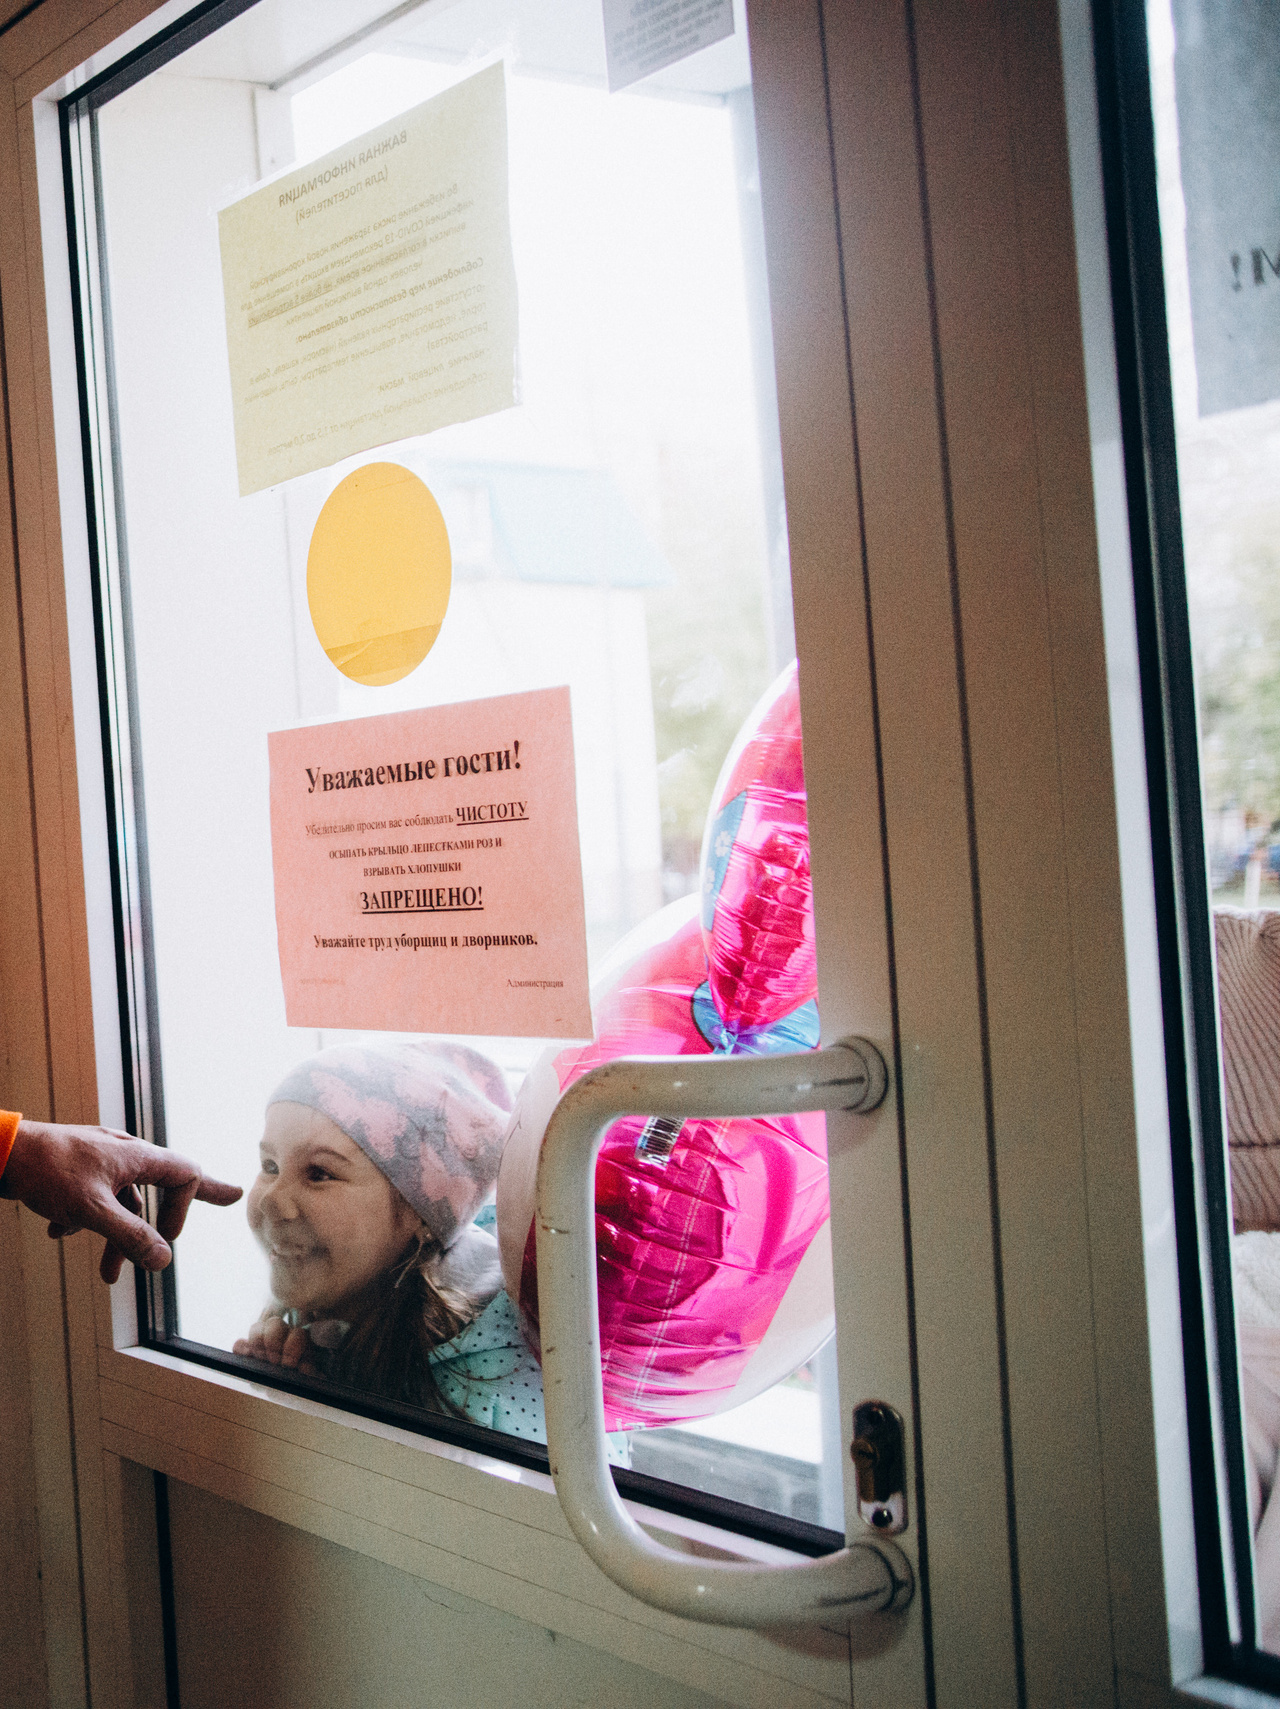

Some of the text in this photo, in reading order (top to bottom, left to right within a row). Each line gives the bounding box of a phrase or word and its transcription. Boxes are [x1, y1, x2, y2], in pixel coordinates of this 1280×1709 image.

[304, 739, 521, 794] Уважаемые гости!
[304, 800, 528, 835] Убедительно просим вас соблюдать ЧИСТОТУ
[328, 836, 502, 859] ОСЫПАТЬ КРЫЛЬЦО ЛЕПЕСТКАМИ РОЗ И
[363, 861, 461, 877] ВЗРЫВАТЬ ХЛОПУШКИ
[360, 885, 483, 912] ЗАПРЕЩЕНО!
[313, 932, 538, 951] Уважайте труд уборщиц и дворников.
[507, 978, 563, 989] Администрация
